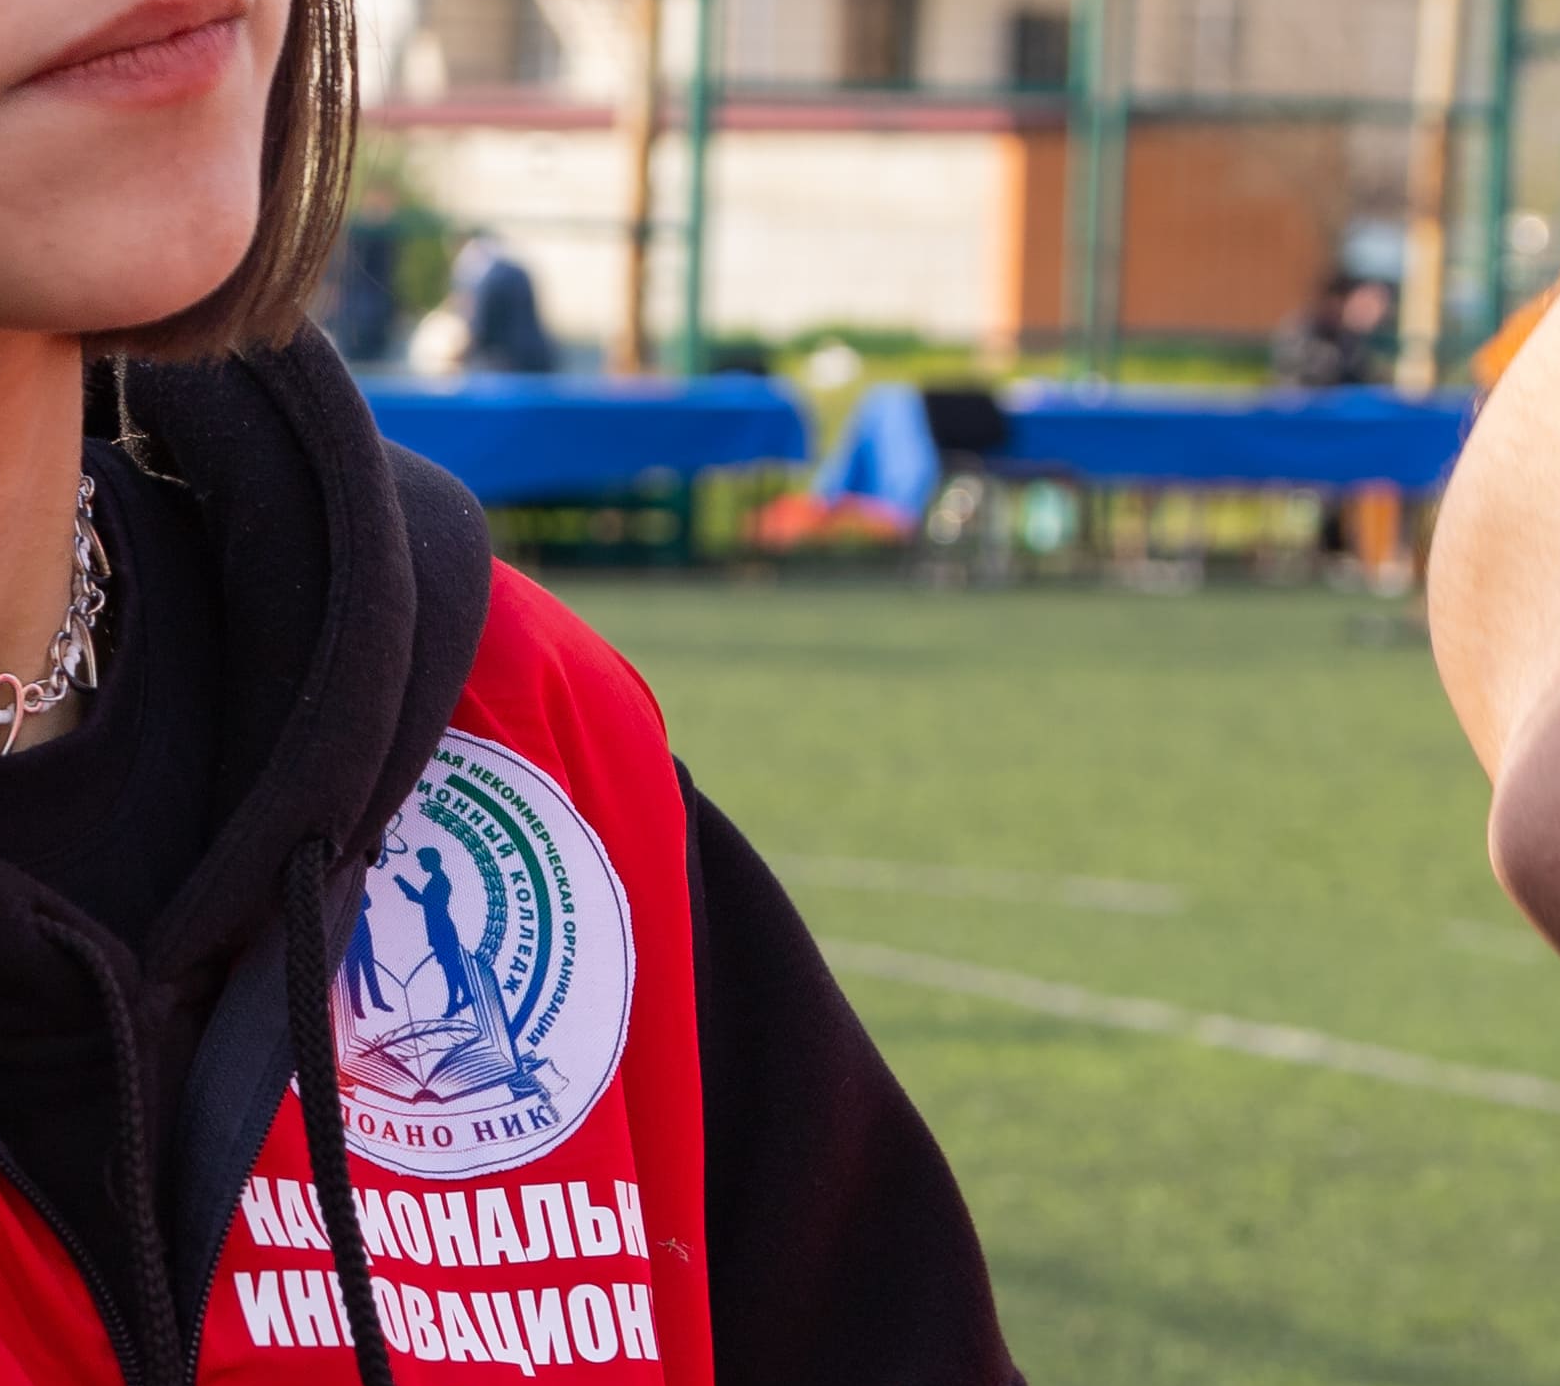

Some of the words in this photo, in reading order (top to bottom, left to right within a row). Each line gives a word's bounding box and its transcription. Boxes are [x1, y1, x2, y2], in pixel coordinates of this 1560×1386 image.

[468, 763, 575, 913] НЕКОММЕРЧЕСКАЯ
[526, 920, 576, 1047] ОРГАНИЗАЦИЯ
[503, 870, 536, 995] КОЛЛЕДЖ
[471, 1105, 554, 1143] НИК
